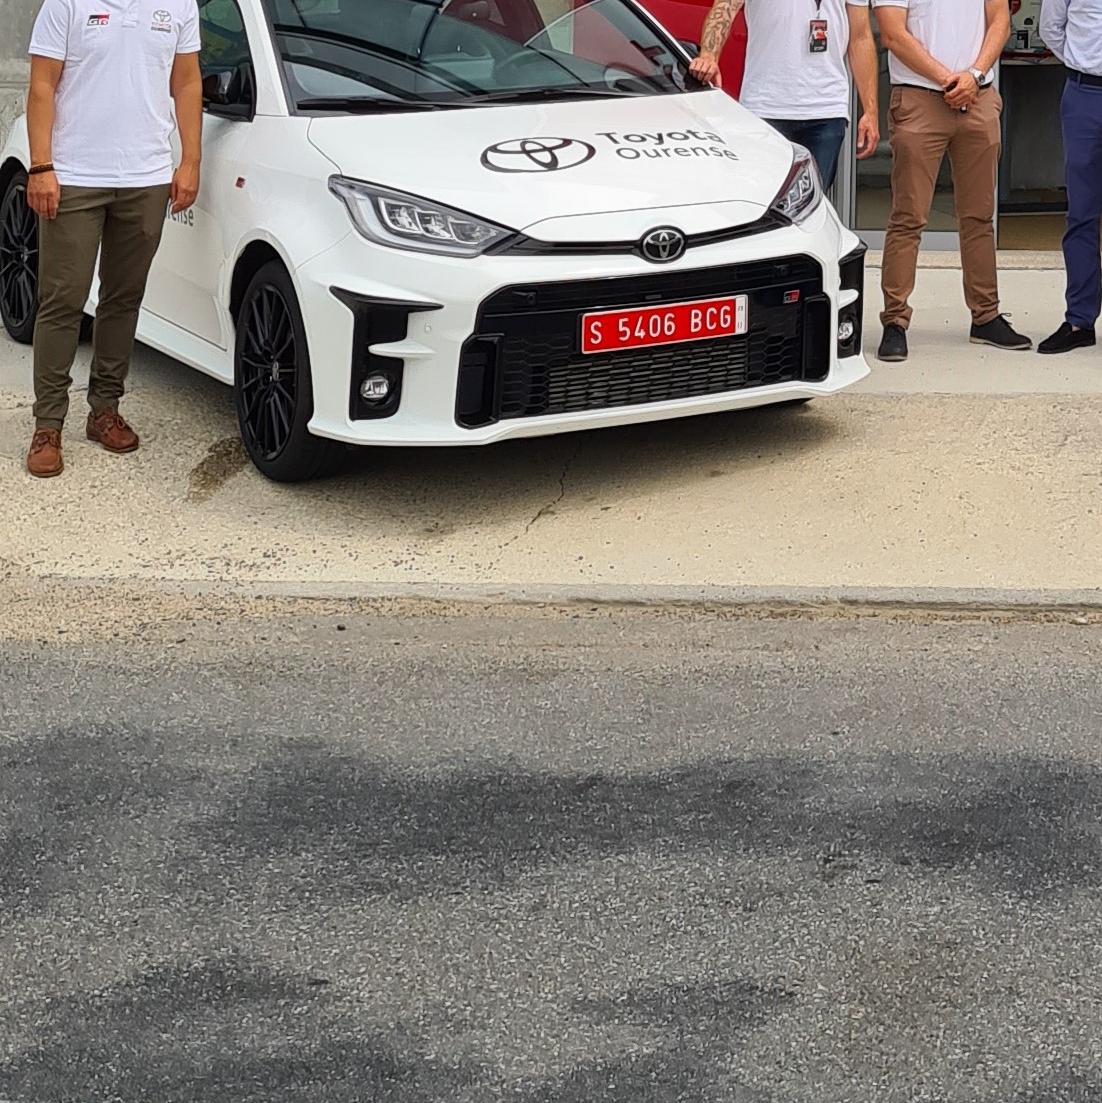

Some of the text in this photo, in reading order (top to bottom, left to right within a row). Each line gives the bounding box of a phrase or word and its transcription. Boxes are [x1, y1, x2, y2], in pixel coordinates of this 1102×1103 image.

[594, 128, 726, 145] Toyota
[615, 144, 739, 161] Ourense
[590, 305, 732, 345] S 5406 BCG
